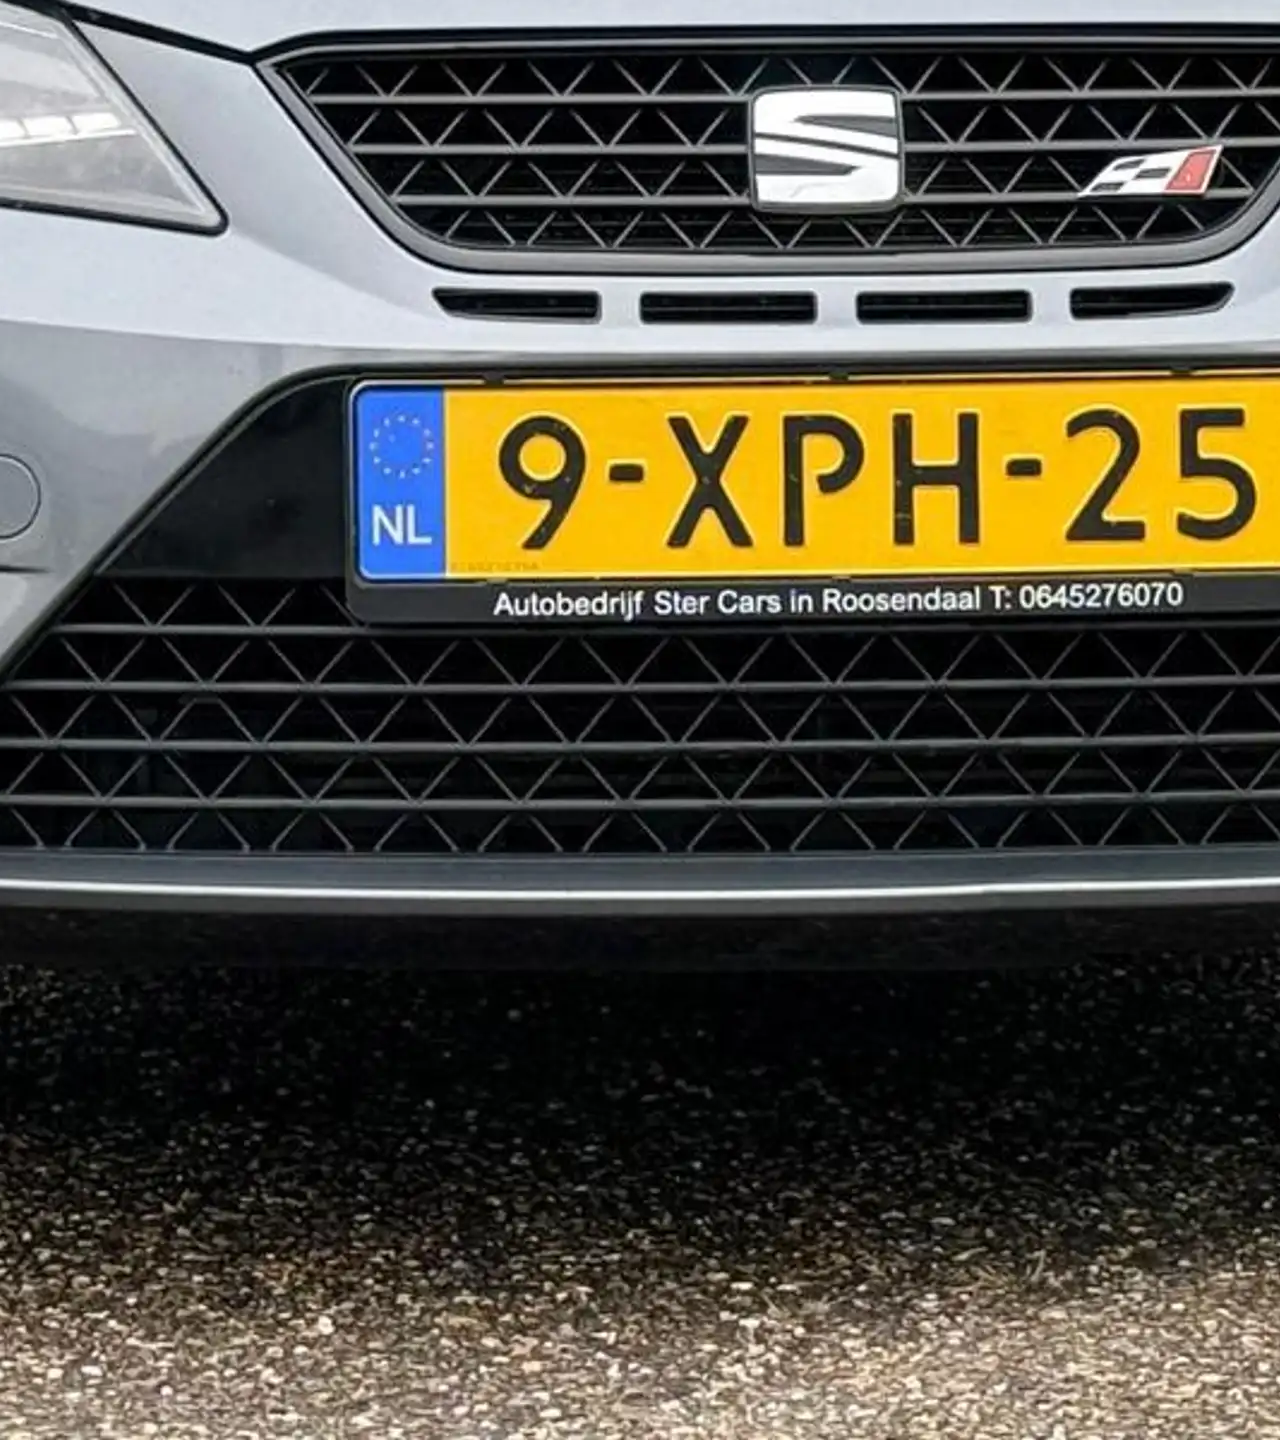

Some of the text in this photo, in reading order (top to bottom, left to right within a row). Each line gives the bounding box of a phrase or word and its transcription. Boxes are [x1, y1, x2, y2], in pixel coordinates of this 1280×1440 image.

[497, 407, 1258, 550] 9-XPH-25
[371, 505, 432, 546] NL
[492, 582, 1184, 621] Autobedrijf Ster Cars in Roosendaal T: 0645276070
